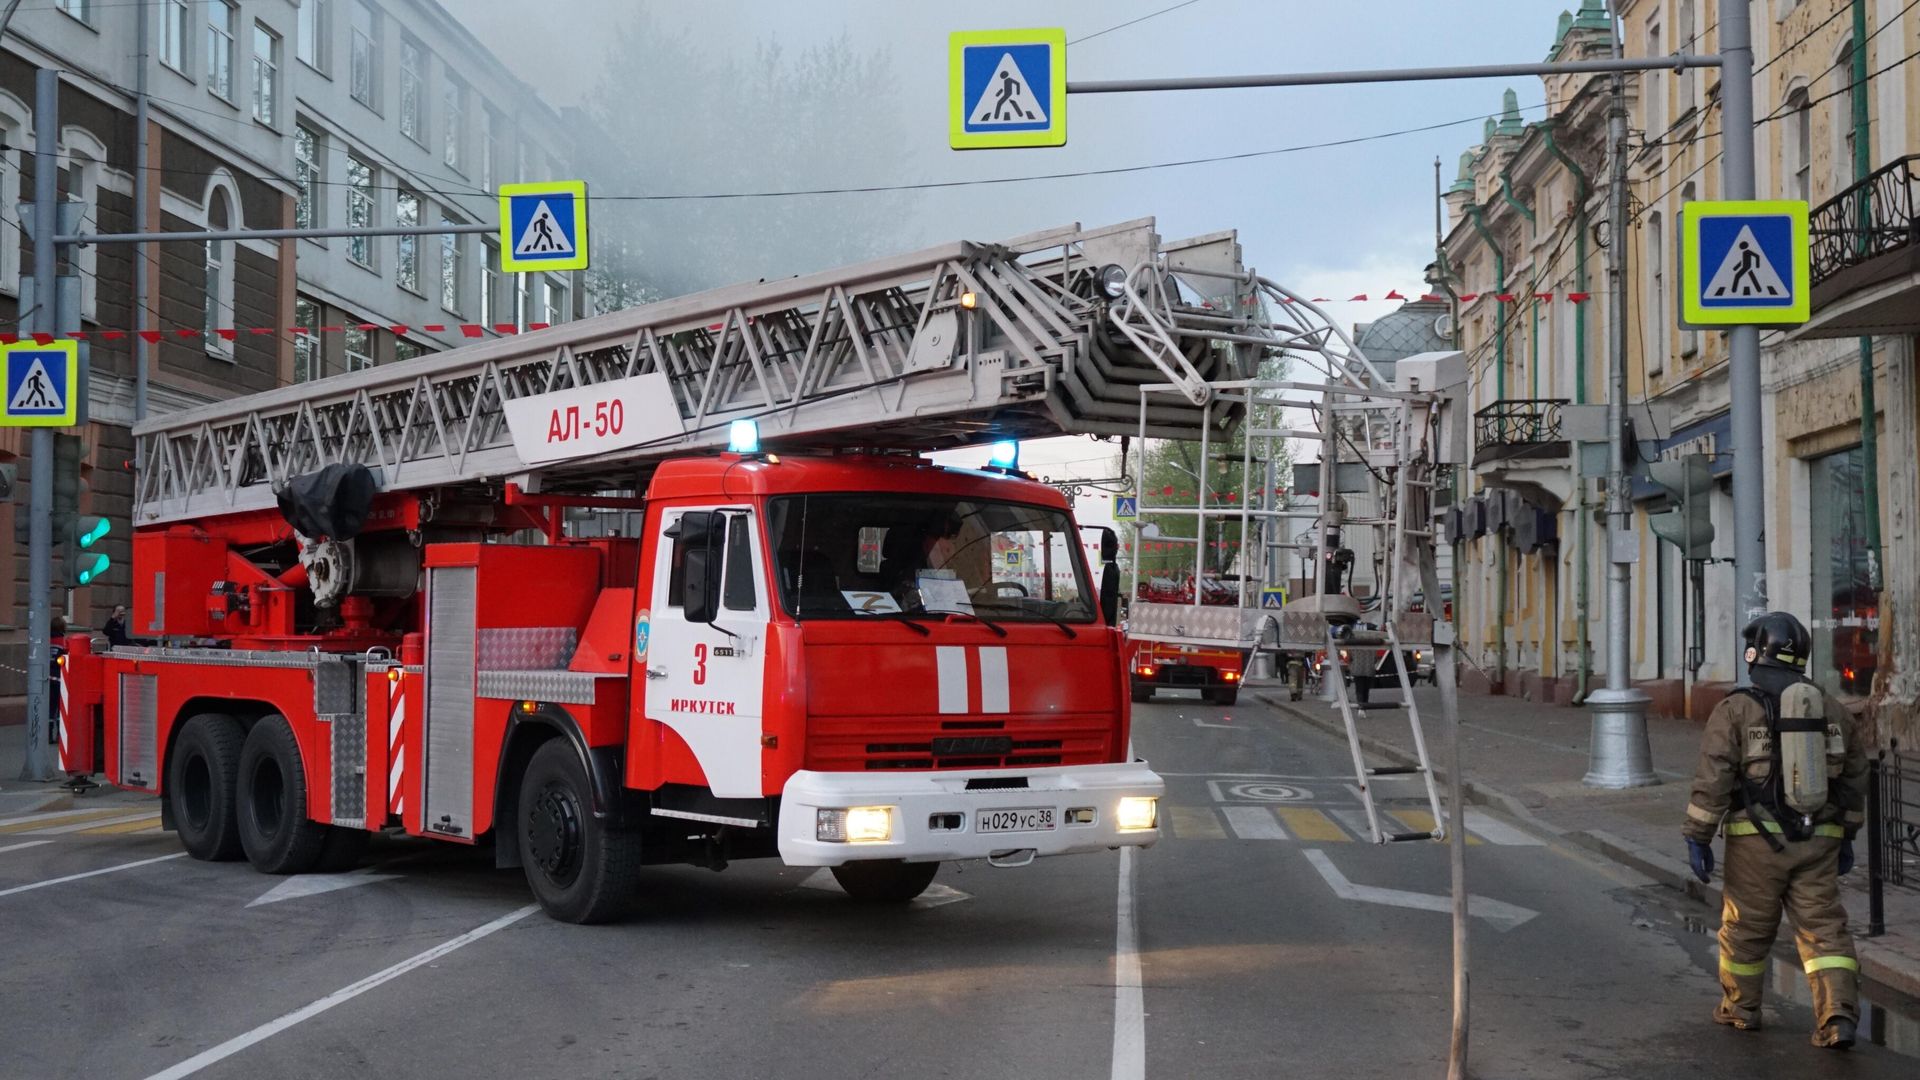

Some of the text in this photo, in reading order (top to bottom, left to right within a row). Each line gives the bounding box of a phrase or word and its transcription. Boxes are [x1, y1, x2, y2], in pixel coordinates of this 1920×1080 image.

[547, 399, 624, 443] АЛ-50
[1781, 639, 1794, 653] 2
[693, 643, 707, 685] 3
[671, 698, 735, 715] ИРКУТСК
[1039, 810, 1052, 822] 38
